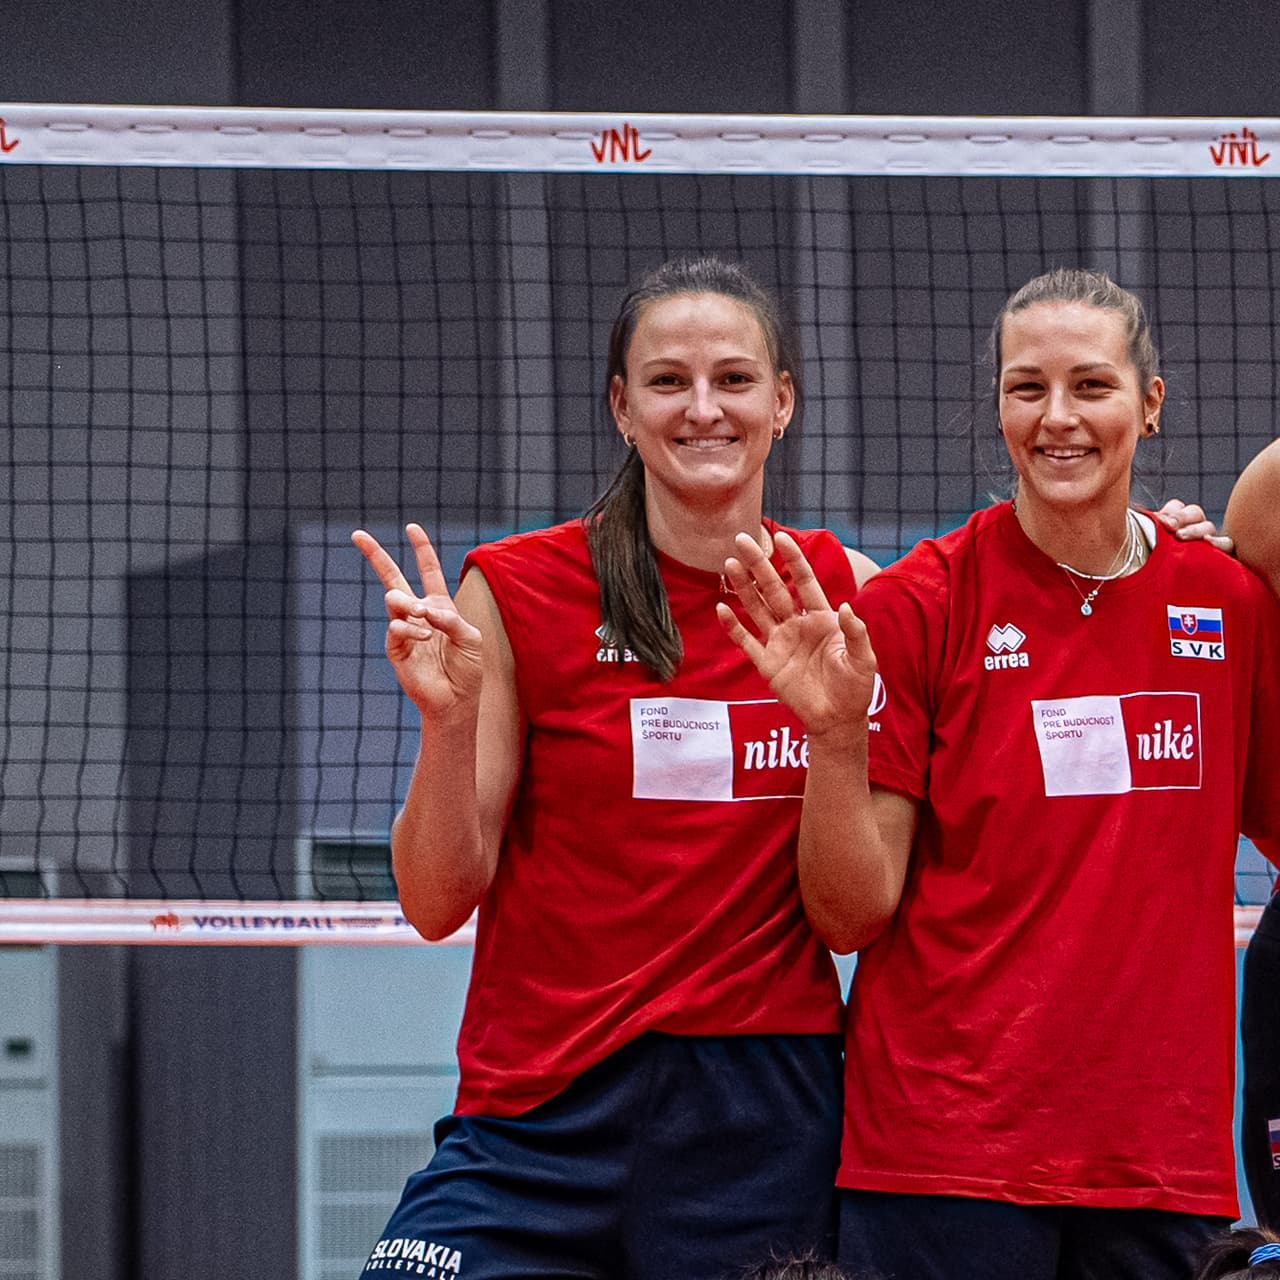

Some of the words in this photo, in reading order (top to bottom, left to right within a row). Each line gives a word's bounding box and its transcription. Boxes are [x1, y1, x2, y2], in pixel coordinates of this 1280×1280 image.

[590, 122, 652, 162] VNL
[1209, 127, 1270, 166] VNL
[984, 652, 1030, 671] errea
[1171, 641, 1223, 659] SVK
[1136, 720, 1195, 761] niké
[372, 1237, 463, 1274] SLOVAKIA
